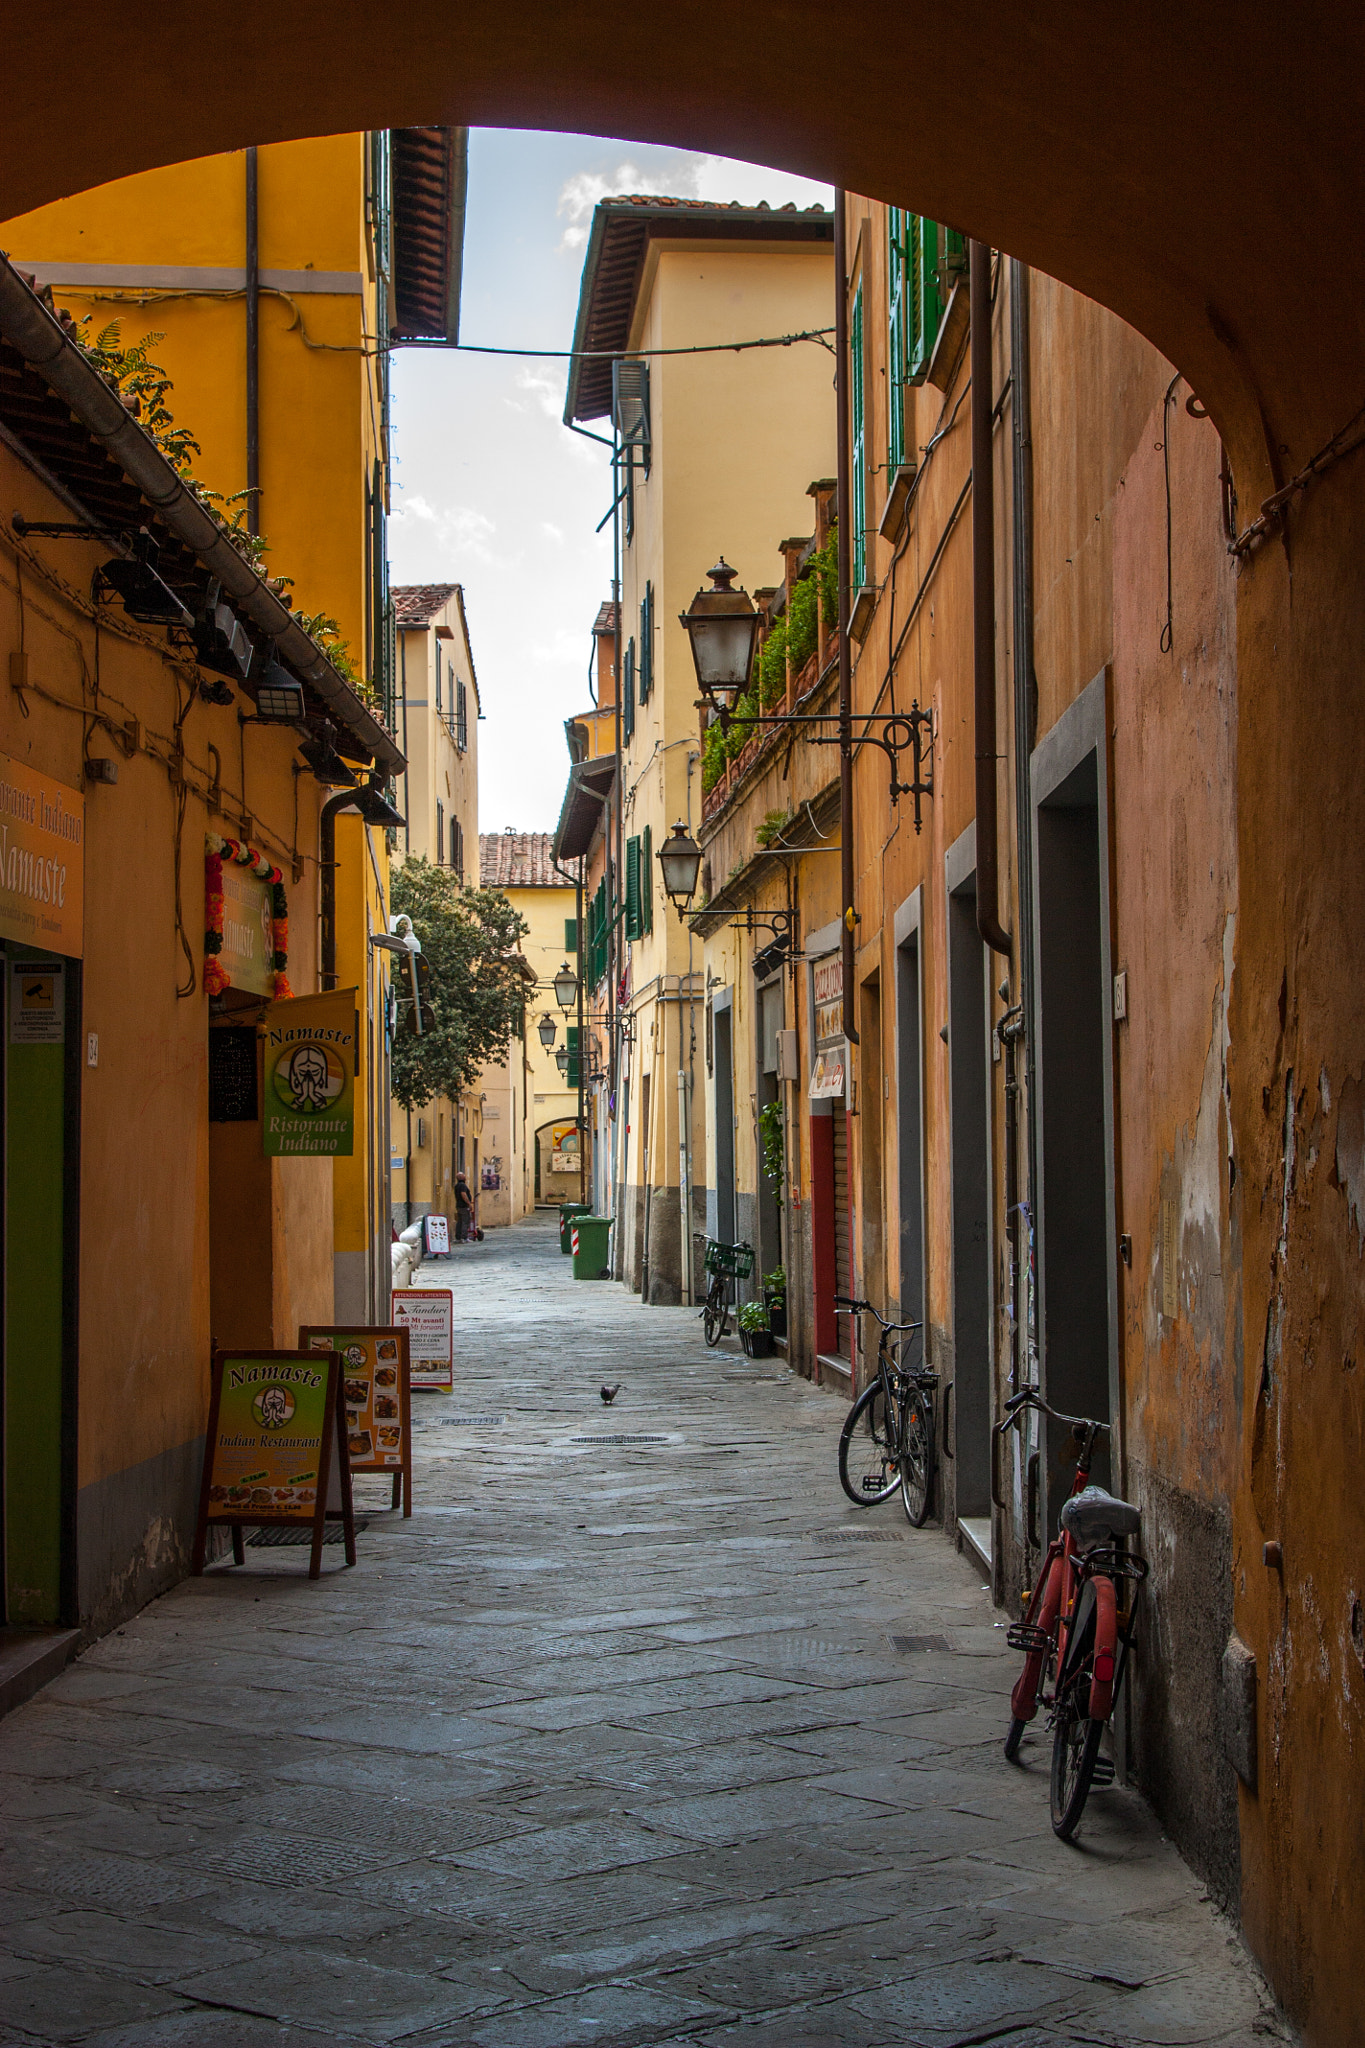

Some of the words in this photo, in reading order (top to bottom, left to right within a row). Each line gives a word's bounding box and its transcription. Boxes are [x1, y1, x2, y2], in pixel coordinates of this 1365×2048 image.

[39, 790, 82, 846] Indiano
[268, 1026, 353, 1048] Namaste
[269, 1116, 348, 1133] Ristorante
[278, 1132, 338, 1152] Indiano
[408, 1305, 449, 1315] Tanduri
[228, 1364, 322, 1390] Namaste
[218, 1431, 256, 1448] Indian
[259, 1434, 321, 1448] Restaurant
